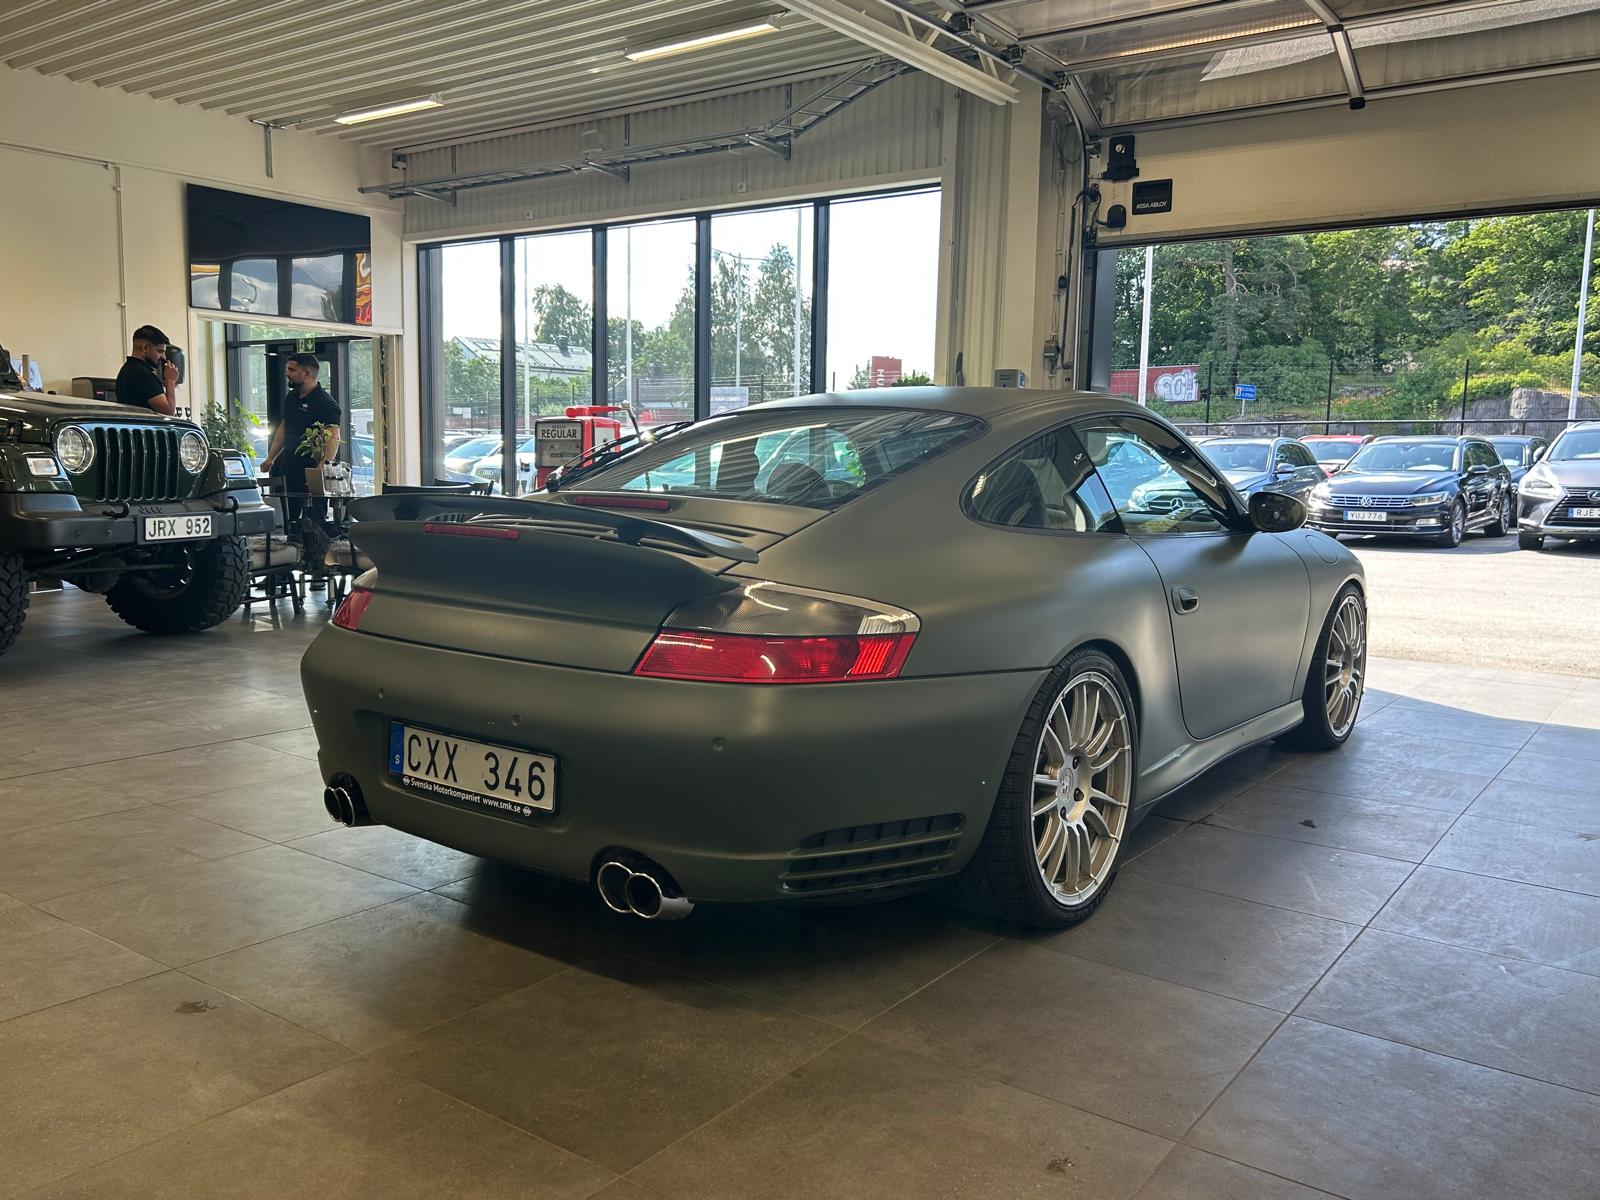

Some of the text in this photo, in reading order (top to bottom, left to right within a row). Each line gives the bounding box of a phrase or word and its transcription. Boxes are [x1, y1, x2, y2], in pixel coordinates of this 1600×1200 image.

[541, 429, 577, 439] REGULAR
[1350, 512, 1366, 520] YUJ
[1576, 508, 1594, 517] RJE
[148, 517, 210, 538] JRX 952
[407, 733, 546, 801] CXX 346
[410, 777, 521, 813] Svenska Motorkompaniet www.smk.se
